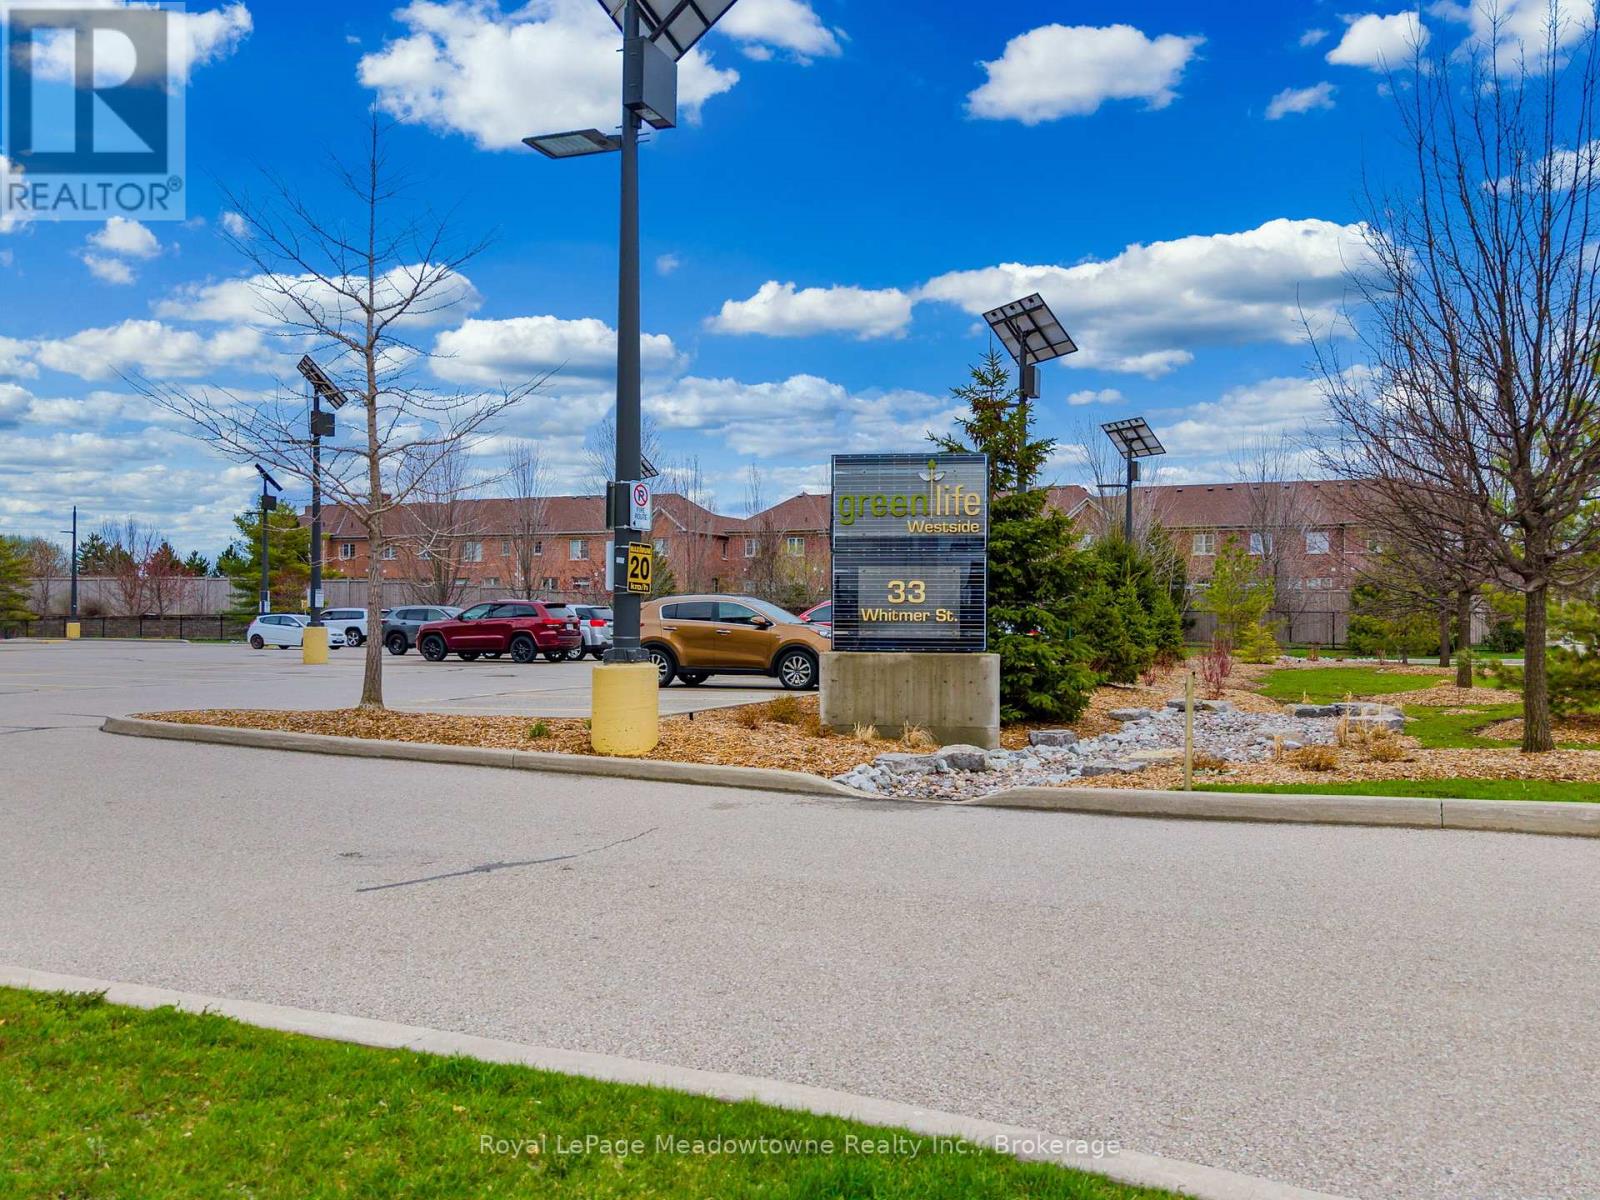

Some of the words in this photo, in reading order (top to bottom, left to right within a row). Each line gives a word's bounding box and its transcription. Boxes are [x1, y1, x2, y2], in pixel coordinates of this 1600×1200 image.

[907, 519, 980, 534] Westside
[630, 555, 650, 580] 20
[630, 583, 649, 591] km/h
[887, 580, 927, 604] 33
[861, 608, 930, 622] Whitmer
[935, 608, 958, 622] St.
